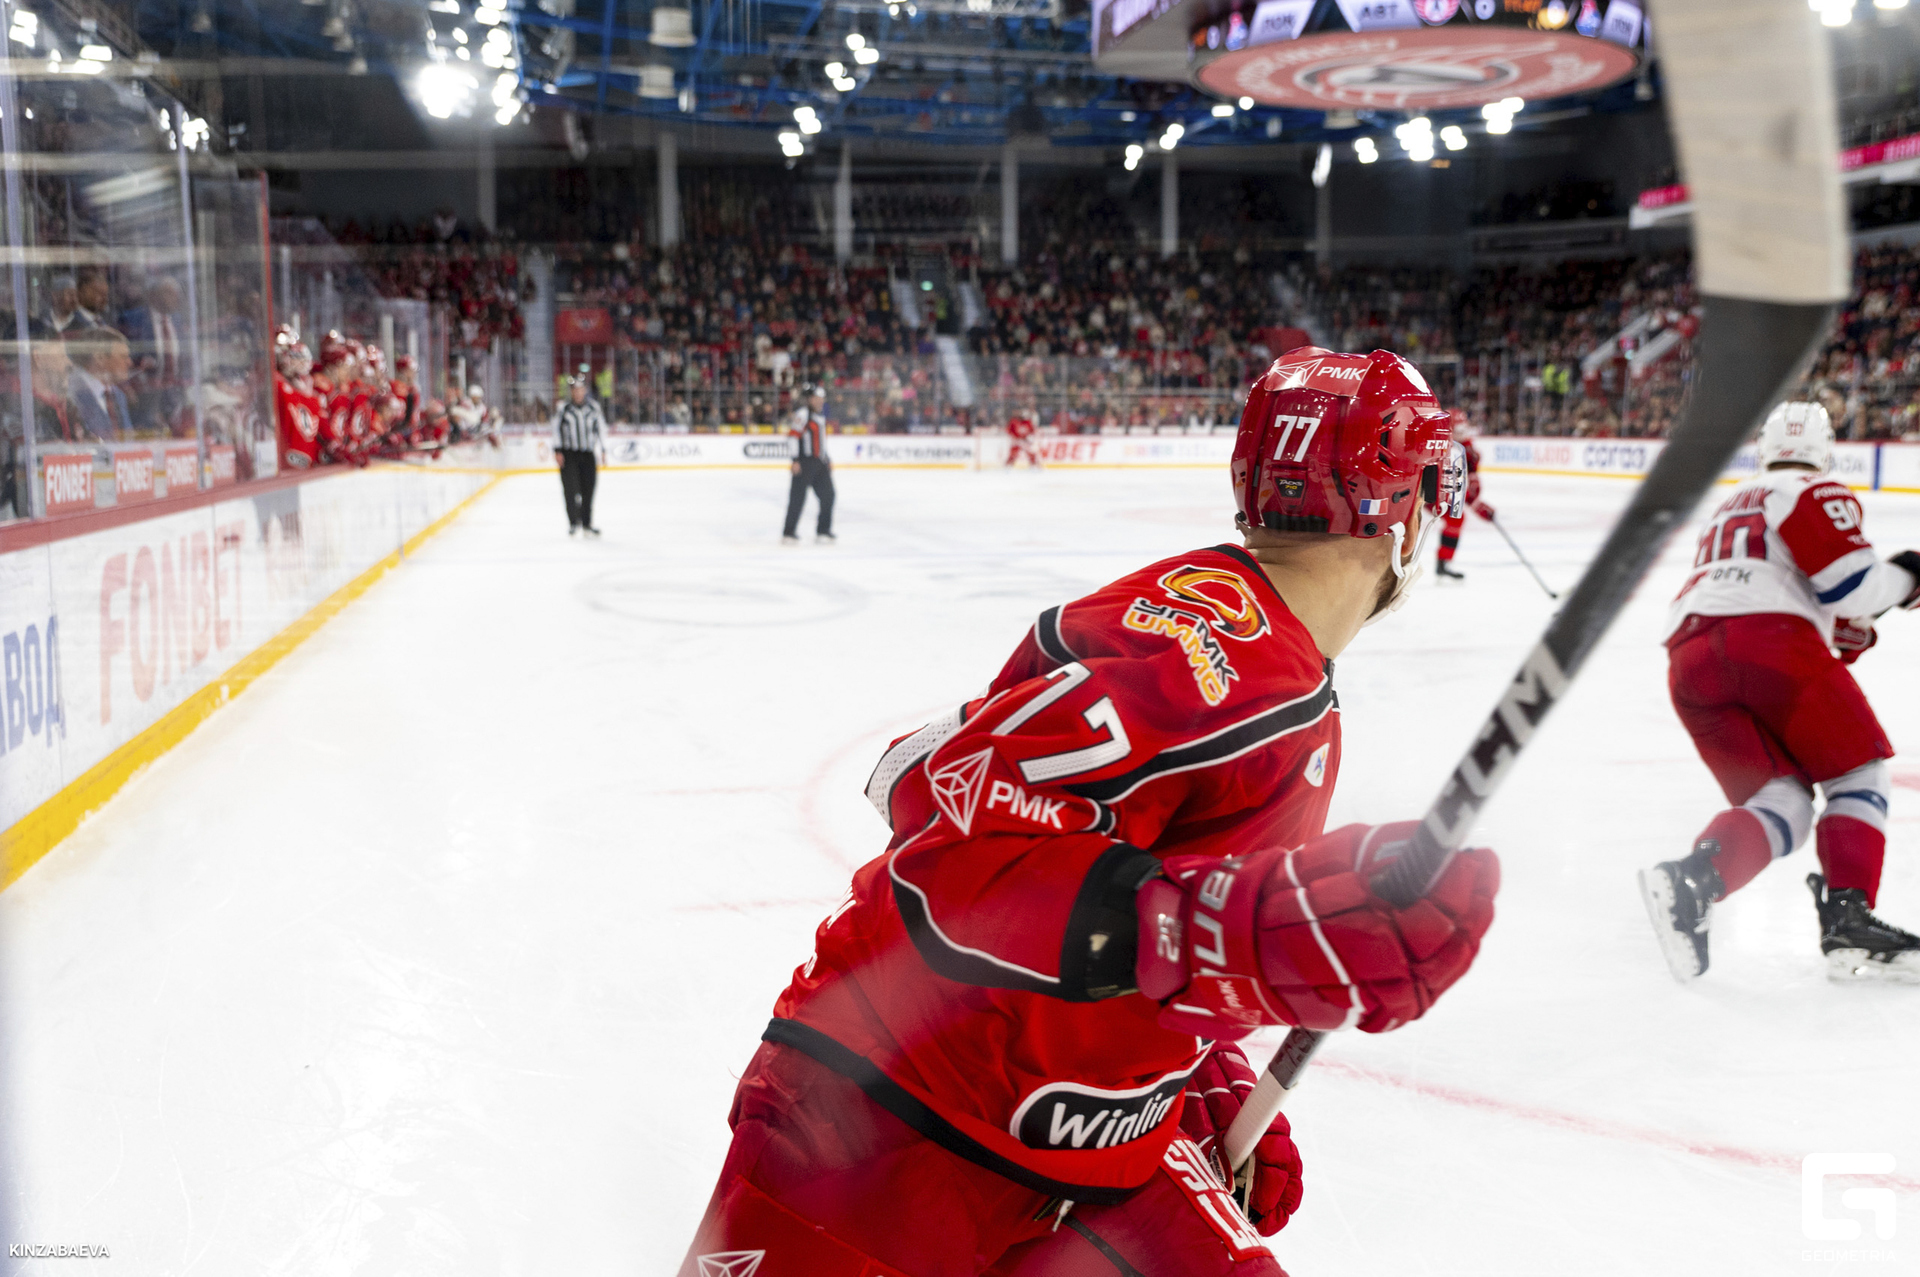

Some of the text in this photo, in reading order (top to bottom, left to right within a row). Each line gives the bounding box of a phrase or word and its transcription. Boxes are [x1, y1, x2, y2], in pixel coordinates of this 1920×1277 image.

[1273, 415, 1321, 462] 77
[46, 462, 93, 505] FONBET
[116, 458, 154, 494] FONBET
[101, 519, 246, 727] FONBET
[0, 614, 67, 757] ВОД
[990, 661, 1133, 785] 77
[1049, 1092, 1177, 1149] Winlin
